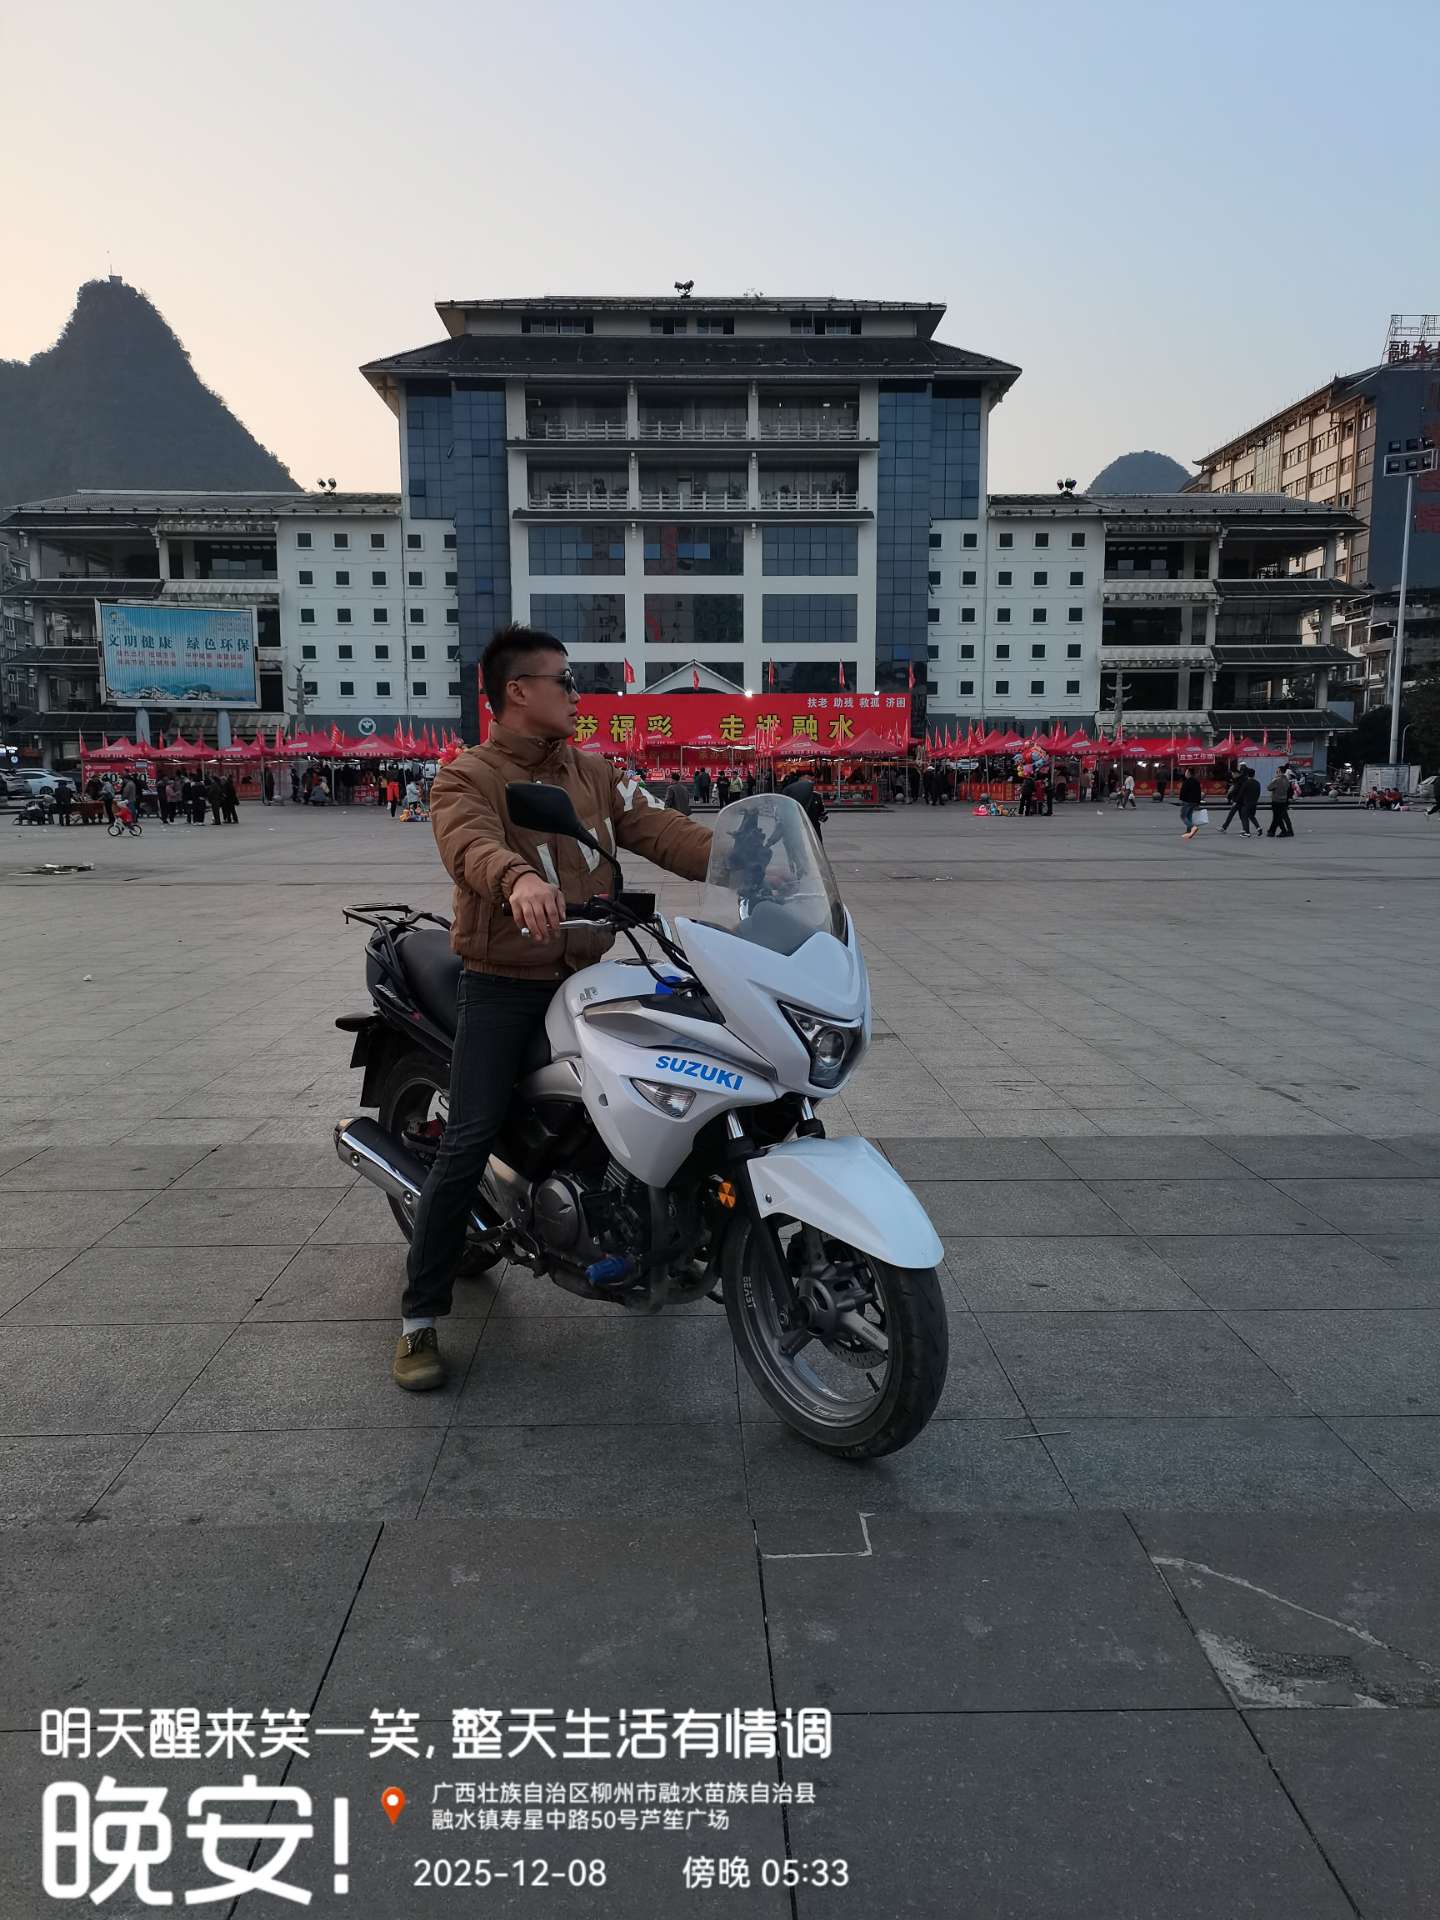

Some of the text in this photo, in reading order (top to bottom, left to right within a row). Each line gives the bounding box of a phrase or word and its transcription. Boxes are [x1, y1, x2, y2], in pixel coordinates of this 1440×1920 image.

[108, 634, 250, 652] 文明健康 绿色环保
[807, 697, 828, 709] 扶老
[885, 697, 906, 709] 济困
[655, 1055, 744, 1091] SUZUKI
